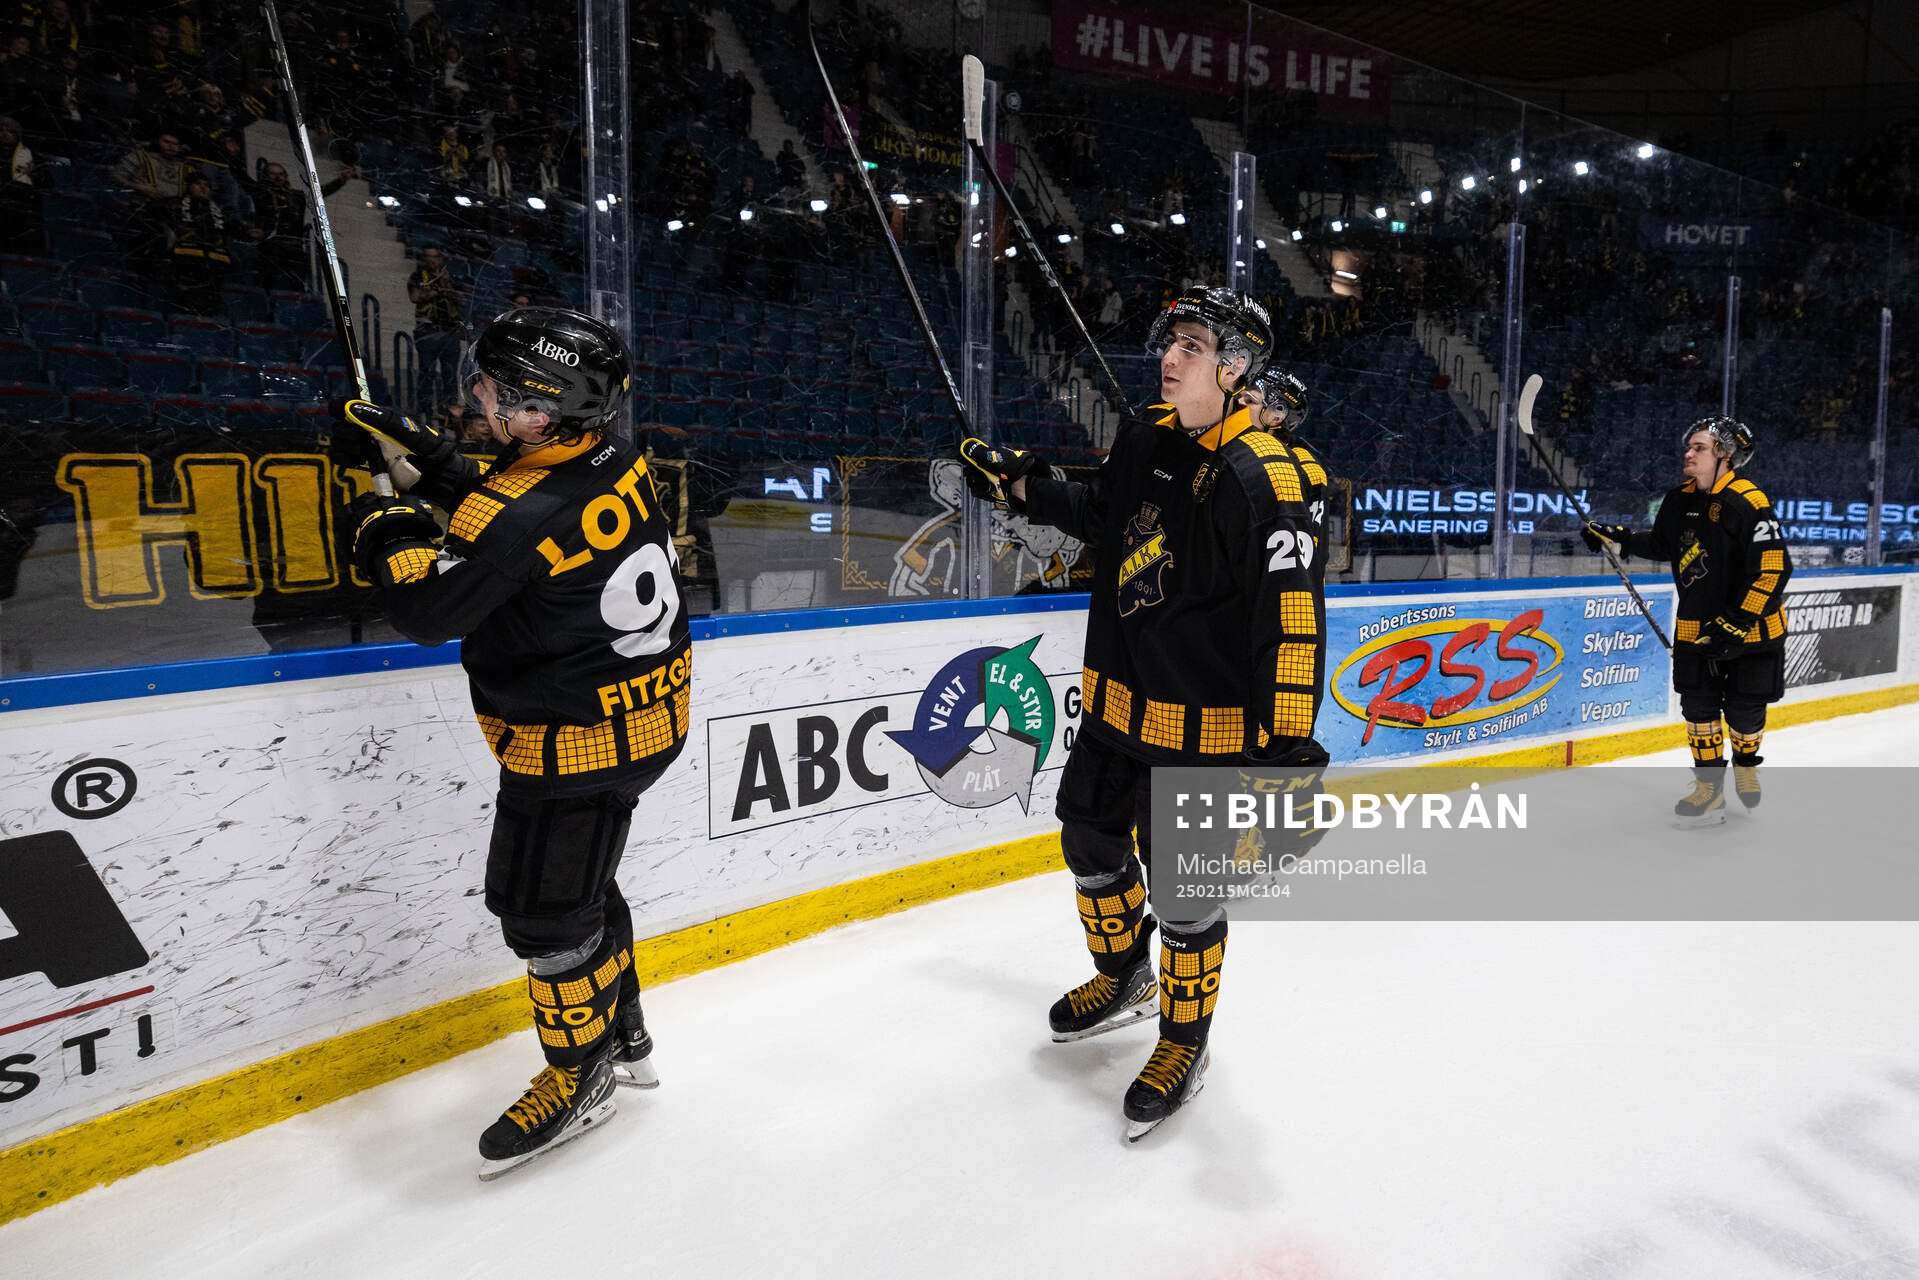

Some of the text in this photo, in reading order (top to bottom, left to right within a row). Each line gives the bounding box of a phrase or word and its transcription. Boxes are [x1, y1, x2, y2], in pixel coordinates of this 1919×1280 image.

[1076, 14, 1372, 99] #LIVE IS LIFE
[1665, 223, 1751, 245] HOVET
[1176, 303, 1201, 313] SVENSKA
[530, 336, 580, 367] ÅBRO
[1245, 331, 1265, 346] CCM
[523, 379, 562, 395] CCM
[590, 444, 617, 466] CCM
[1153, 468, 1173, 481] CCM
[1363, 519, 1489, 534] SANERING
[1266, 530, 1314, 573] 29
[600, 527, 681, 658] 9
[1358, 604, 1456, 643] Robertssons
[1715, 616, 1748, 638] CCM
[1786, 603, 1873, 632] NSPORTER AB
[1582, 630, 1643, 657] Skyltar
[1358, 609, 1545, 747] RSS
[1580, 663, 1640, 689] Solfilm
[928, 675, 966, 732] VENT
[989, 663, 1042, 731] EL & STYR
[1580, 698, 1631, 723] Vepor
[1423, 698, 1549, 749] Skylt & Solfilm AB
[731, 705, 888, 822] ABC
[962, 764, 1000, 792] PLÅT
[1161, 935, 1188, 949] CCM
[1119, 981, 1147, 1011] CCM
